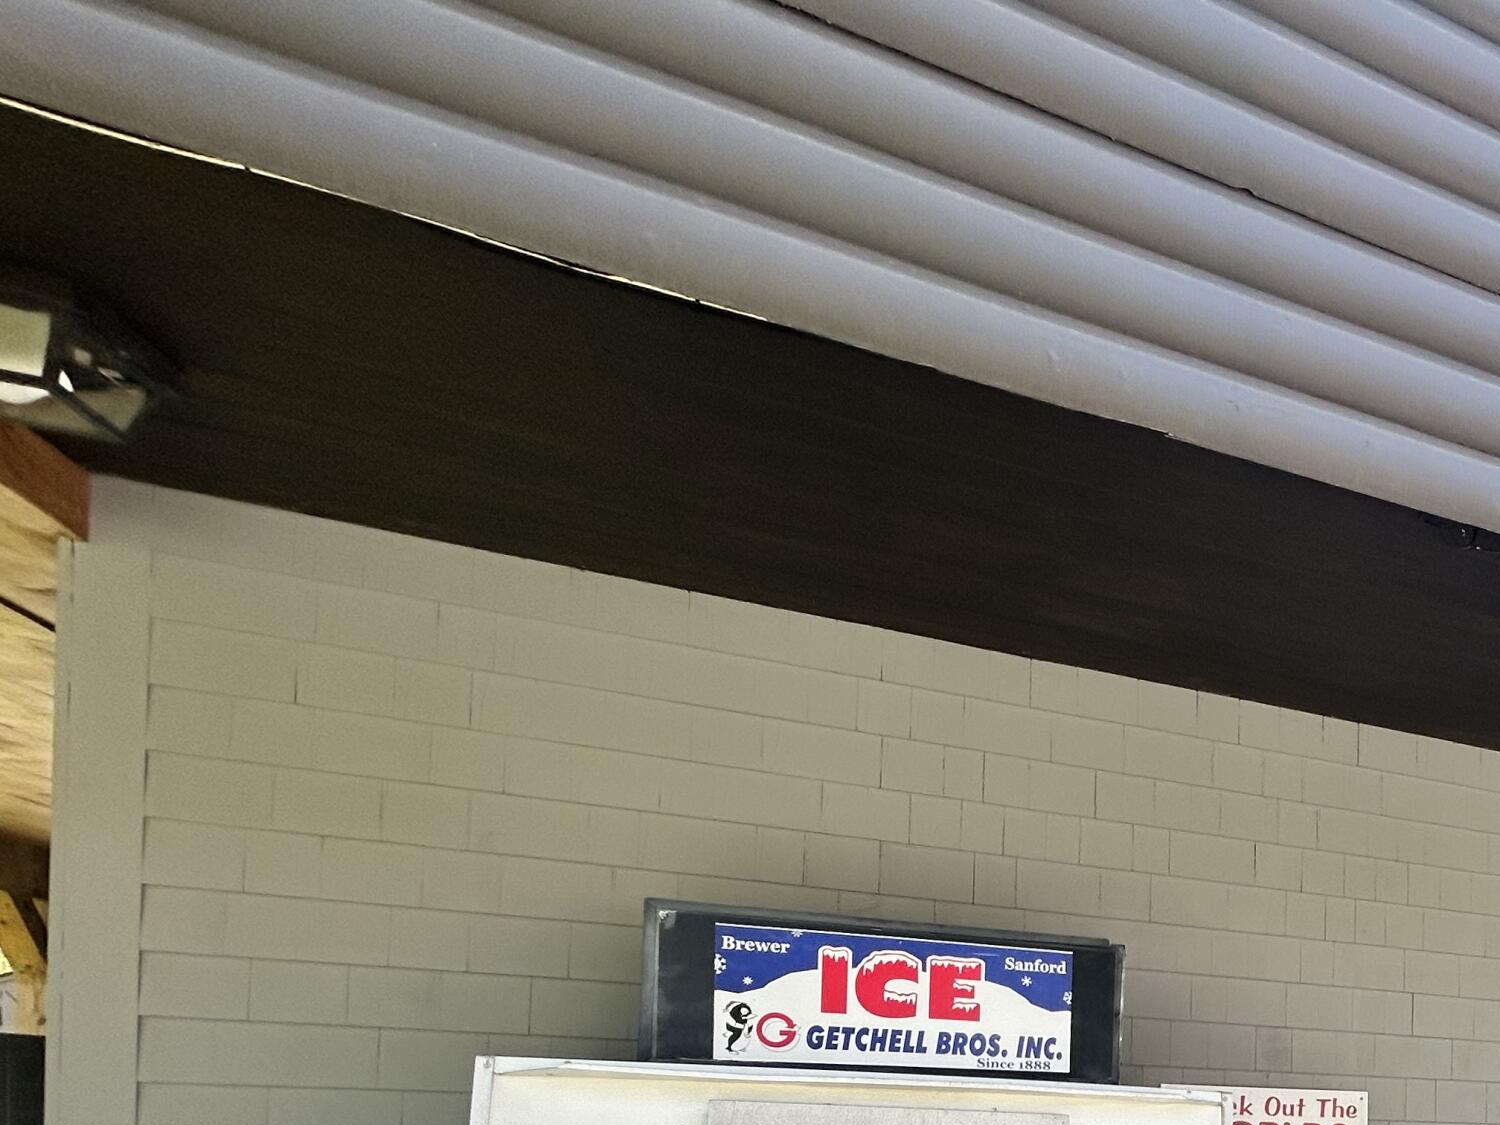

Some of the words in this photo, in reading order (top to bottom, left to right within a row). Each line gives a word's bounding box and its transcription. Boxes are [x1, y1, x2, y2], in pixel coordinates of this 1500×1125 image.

[721, 934, 791, 954] Brewer
[1004, 957, 1068, 976] Sanford
[820, 945, 983, 1022] ICE
[806, 1025, 928, 1055] GETCHELL
[935, 1032, 1009, 1057] BROS.
[1016, 1035, 1063, 1061] INC.
[976, 1058, 1015, 1070] Since
[1019, 1061, 1052, 1071] 1888
[1264, 1096, 1306, 1117] Out
[1316, 1097, 1358, 1119] The
